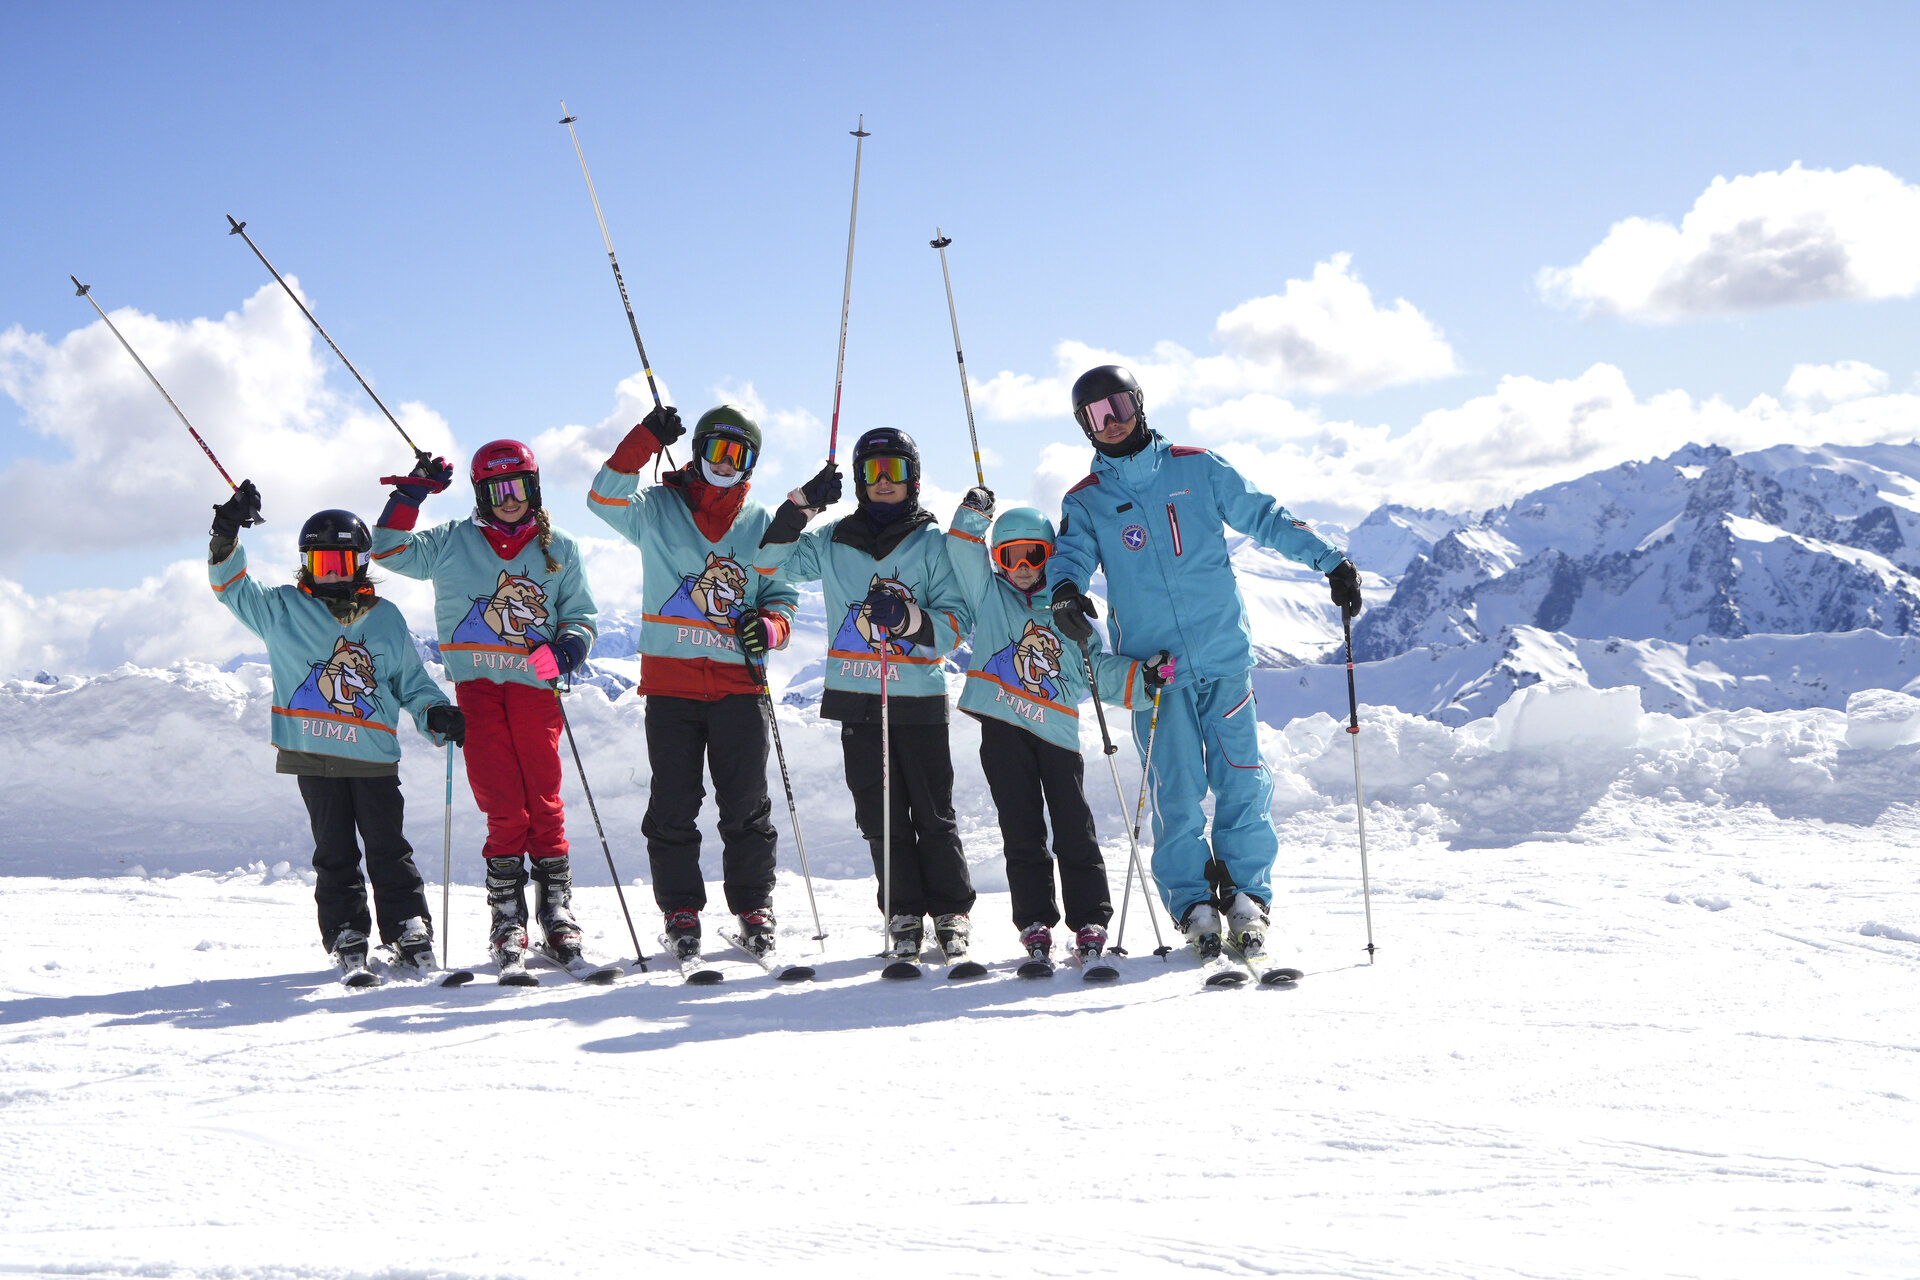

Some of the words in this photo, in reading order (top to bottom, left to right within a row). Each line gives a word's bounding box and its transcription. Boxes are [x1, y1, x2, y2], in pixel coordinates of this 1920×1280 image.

[614, 268, 633, 313] SCOTT
[675, 627, 738, 652] PUMA
[472, 652, 529, 673] PUMA
[840, 660, 900, 681] PUMA
[302, 719, 358, 743] PUMA
